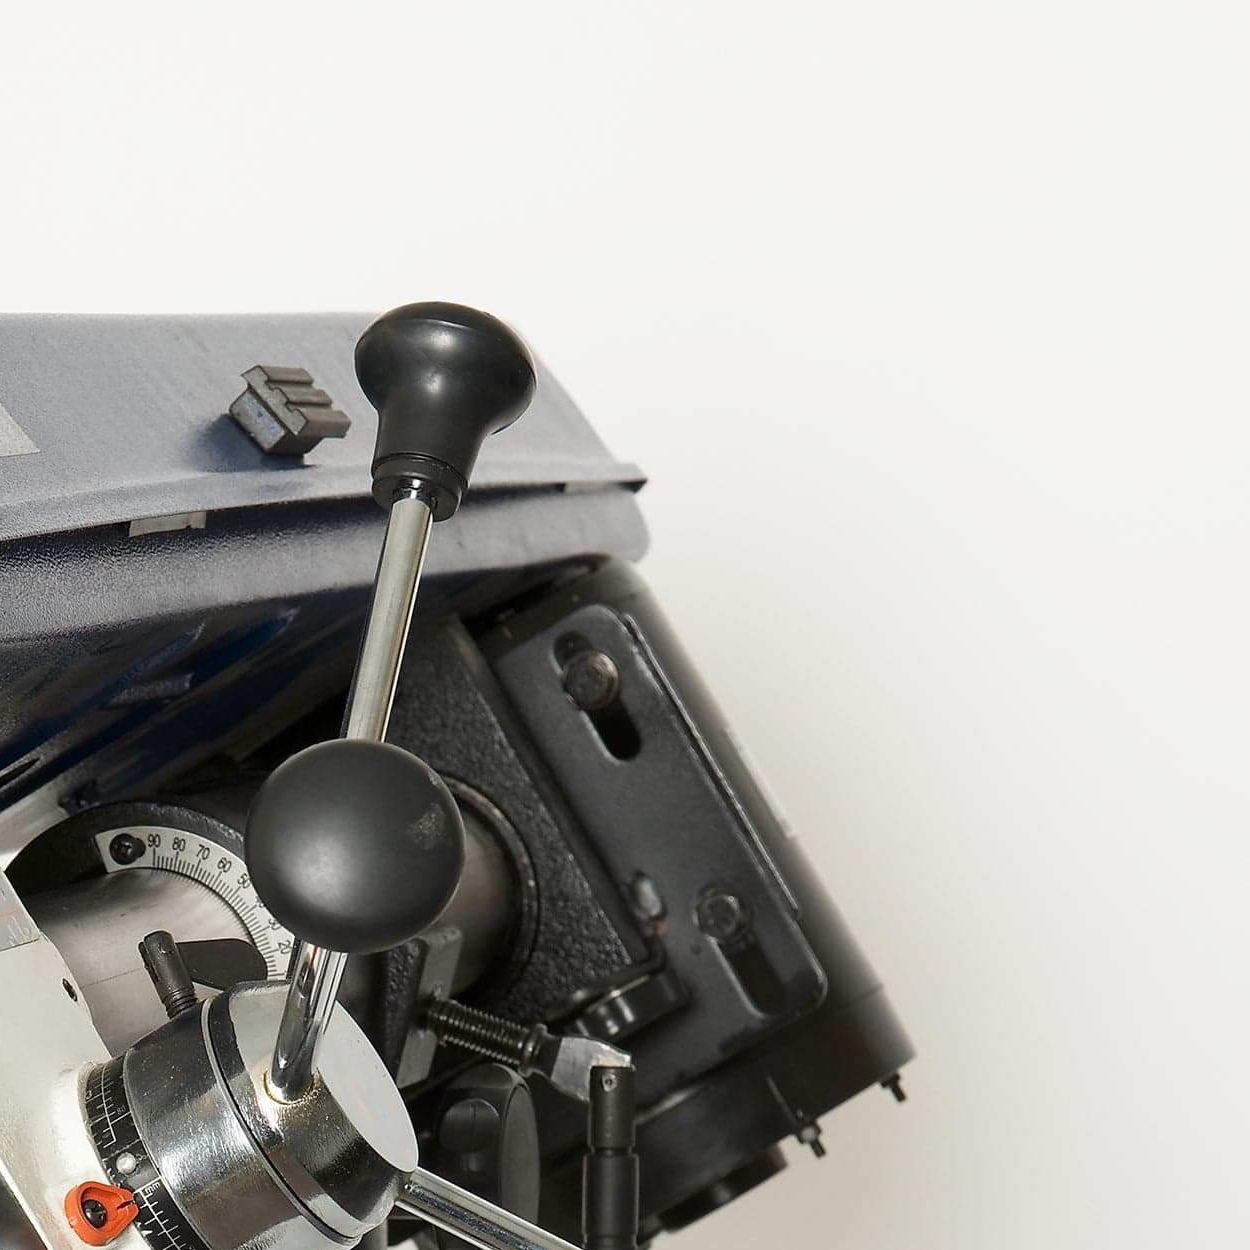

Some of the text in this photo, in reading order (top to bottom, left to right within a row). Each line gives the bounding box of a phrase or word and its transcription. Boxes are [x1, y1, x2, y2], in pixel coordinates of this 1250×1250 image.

[147, 833, 161, 848] 90
[172, 837, 186, 852] 80
[196, 843, 210, 860] 70
[217, 857, 232, 873] 60
[237, 872, 250, 889] 50
[278, 939, 292, 955] 20
[145, 1181, 160, 1194] mm
